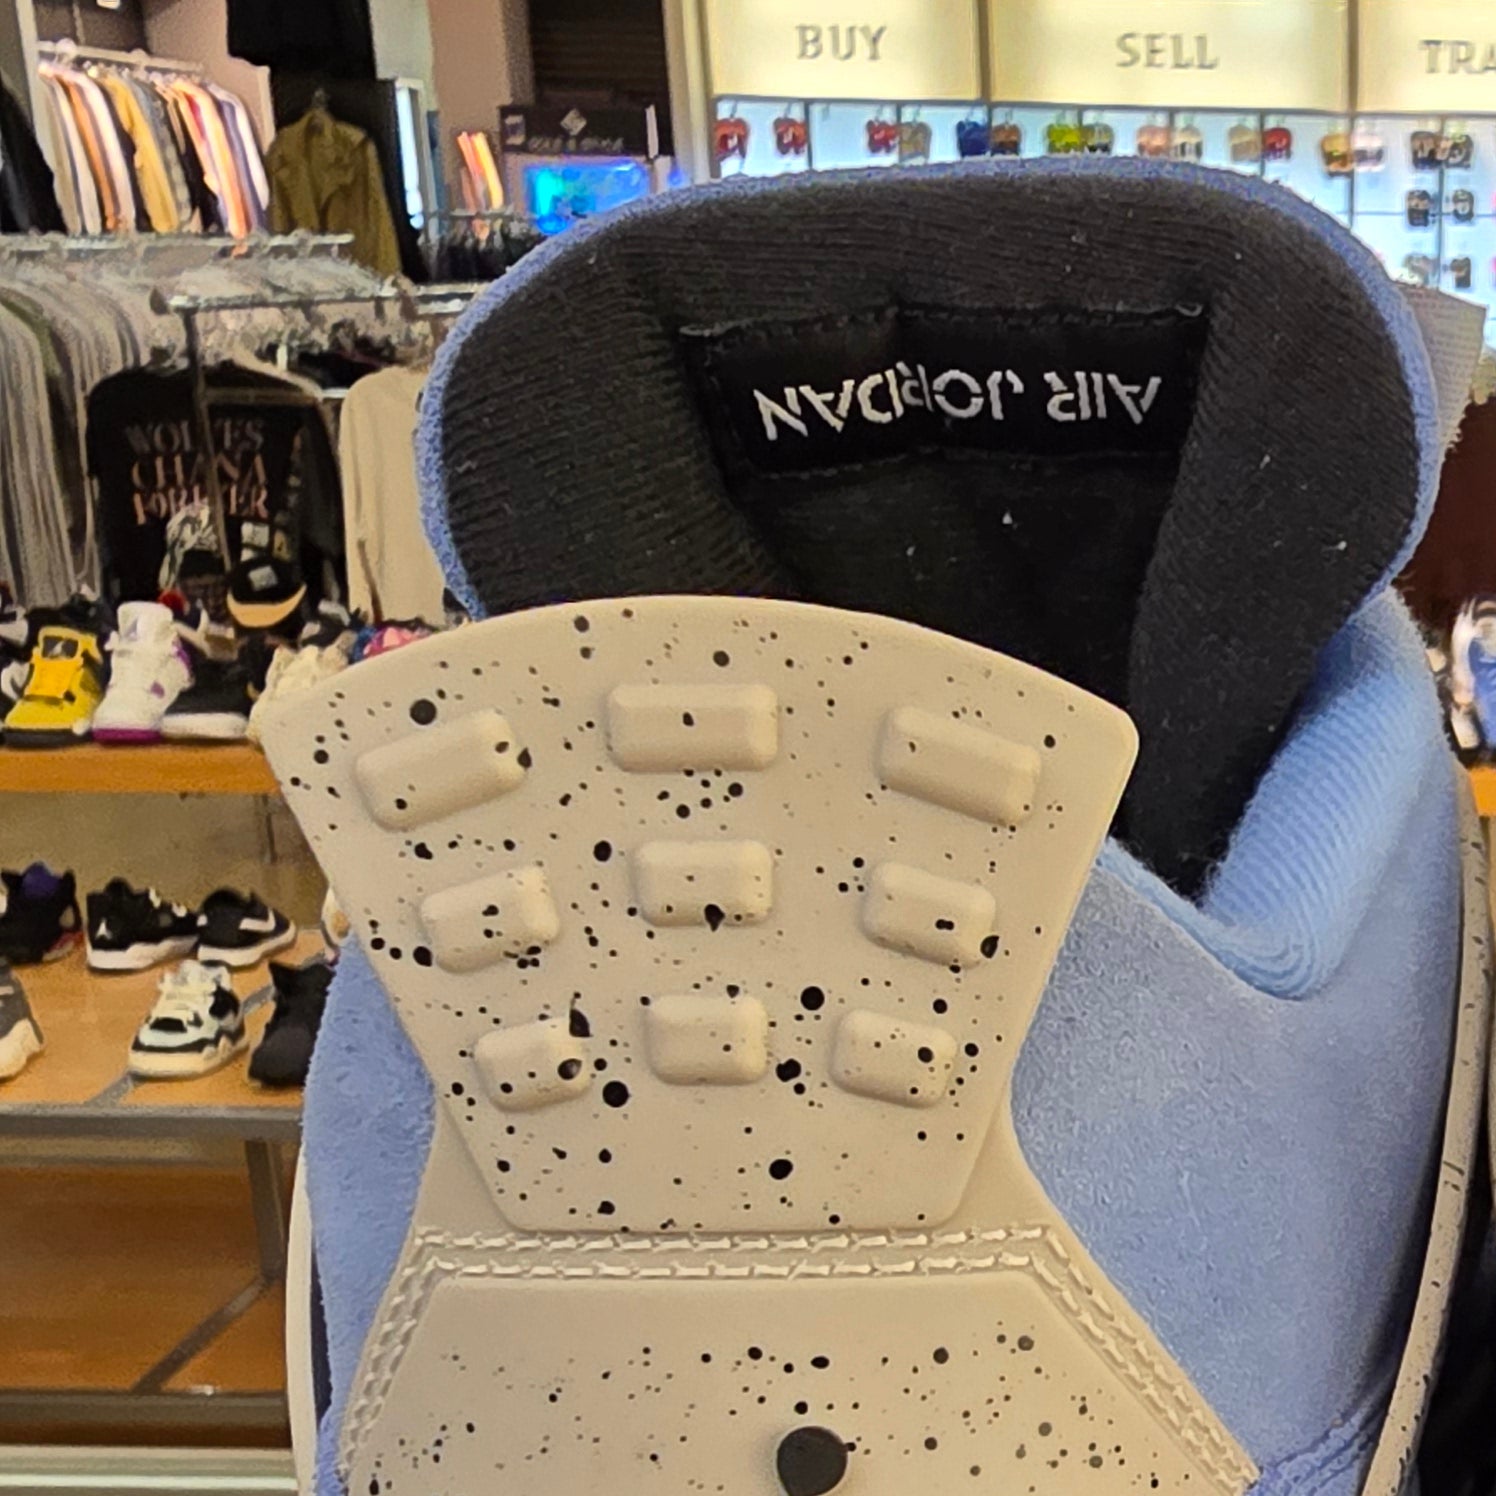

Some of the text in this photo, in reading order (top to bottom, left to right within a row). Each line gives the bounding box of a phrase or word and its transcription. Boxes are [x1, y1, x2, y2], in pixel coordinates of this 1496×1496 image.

[795, 24, 888, 61] BUY
[1115, 32, 1220, 70] SELL
[752, 361, 1162, 441] AIR JORDAN
